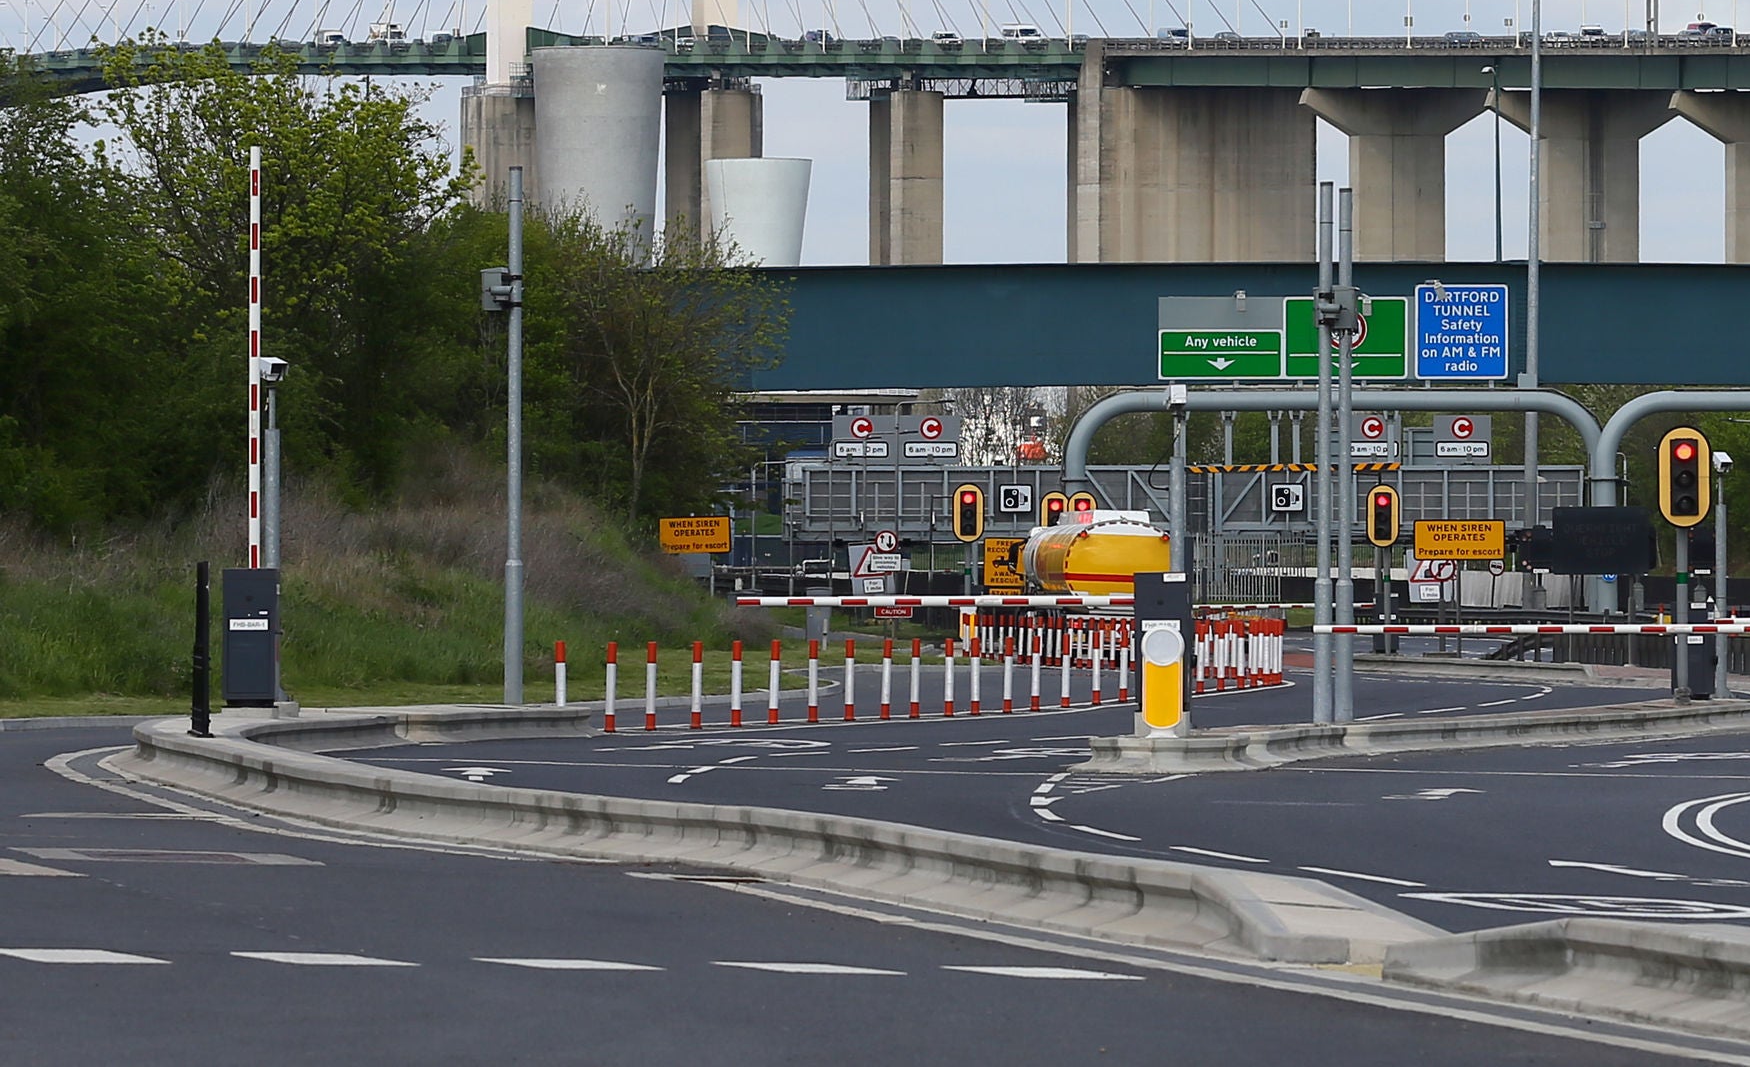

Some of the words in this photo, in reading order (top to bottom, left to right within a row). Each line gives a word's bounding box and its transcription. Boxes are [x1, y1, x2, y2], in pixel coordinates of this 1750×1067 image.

[1433, 305, 1491, 317] TUNNEL
[1441, 318, 1483, 332] Safety
[1184, 334, 1209, 349] Any
[1212, 335, 1257, 347] vehicle
[1425, 332, 1499, 344] Information
[1421, 348, 1438, 358] on
[1441, 346, 1463, 358] AM
[1467, 346, 1477, 358] &
[1481, 346, 1501, 358] FM
[1445, 360, 1478, 372] radio
[668, 520, 693, 528] WHEN
[695, 519, 720, 528] SIREN
[1426, 523, 1458, 532] WHEN
[1460, 523, 1492, 532] SIREN
[673, 528, 715, 537] OPERATES
[1433, 533, 1486, 541] OPERATES
[662, 542, 691, 550] Prepare
[1418, 548, 1454, 556] Prepare
